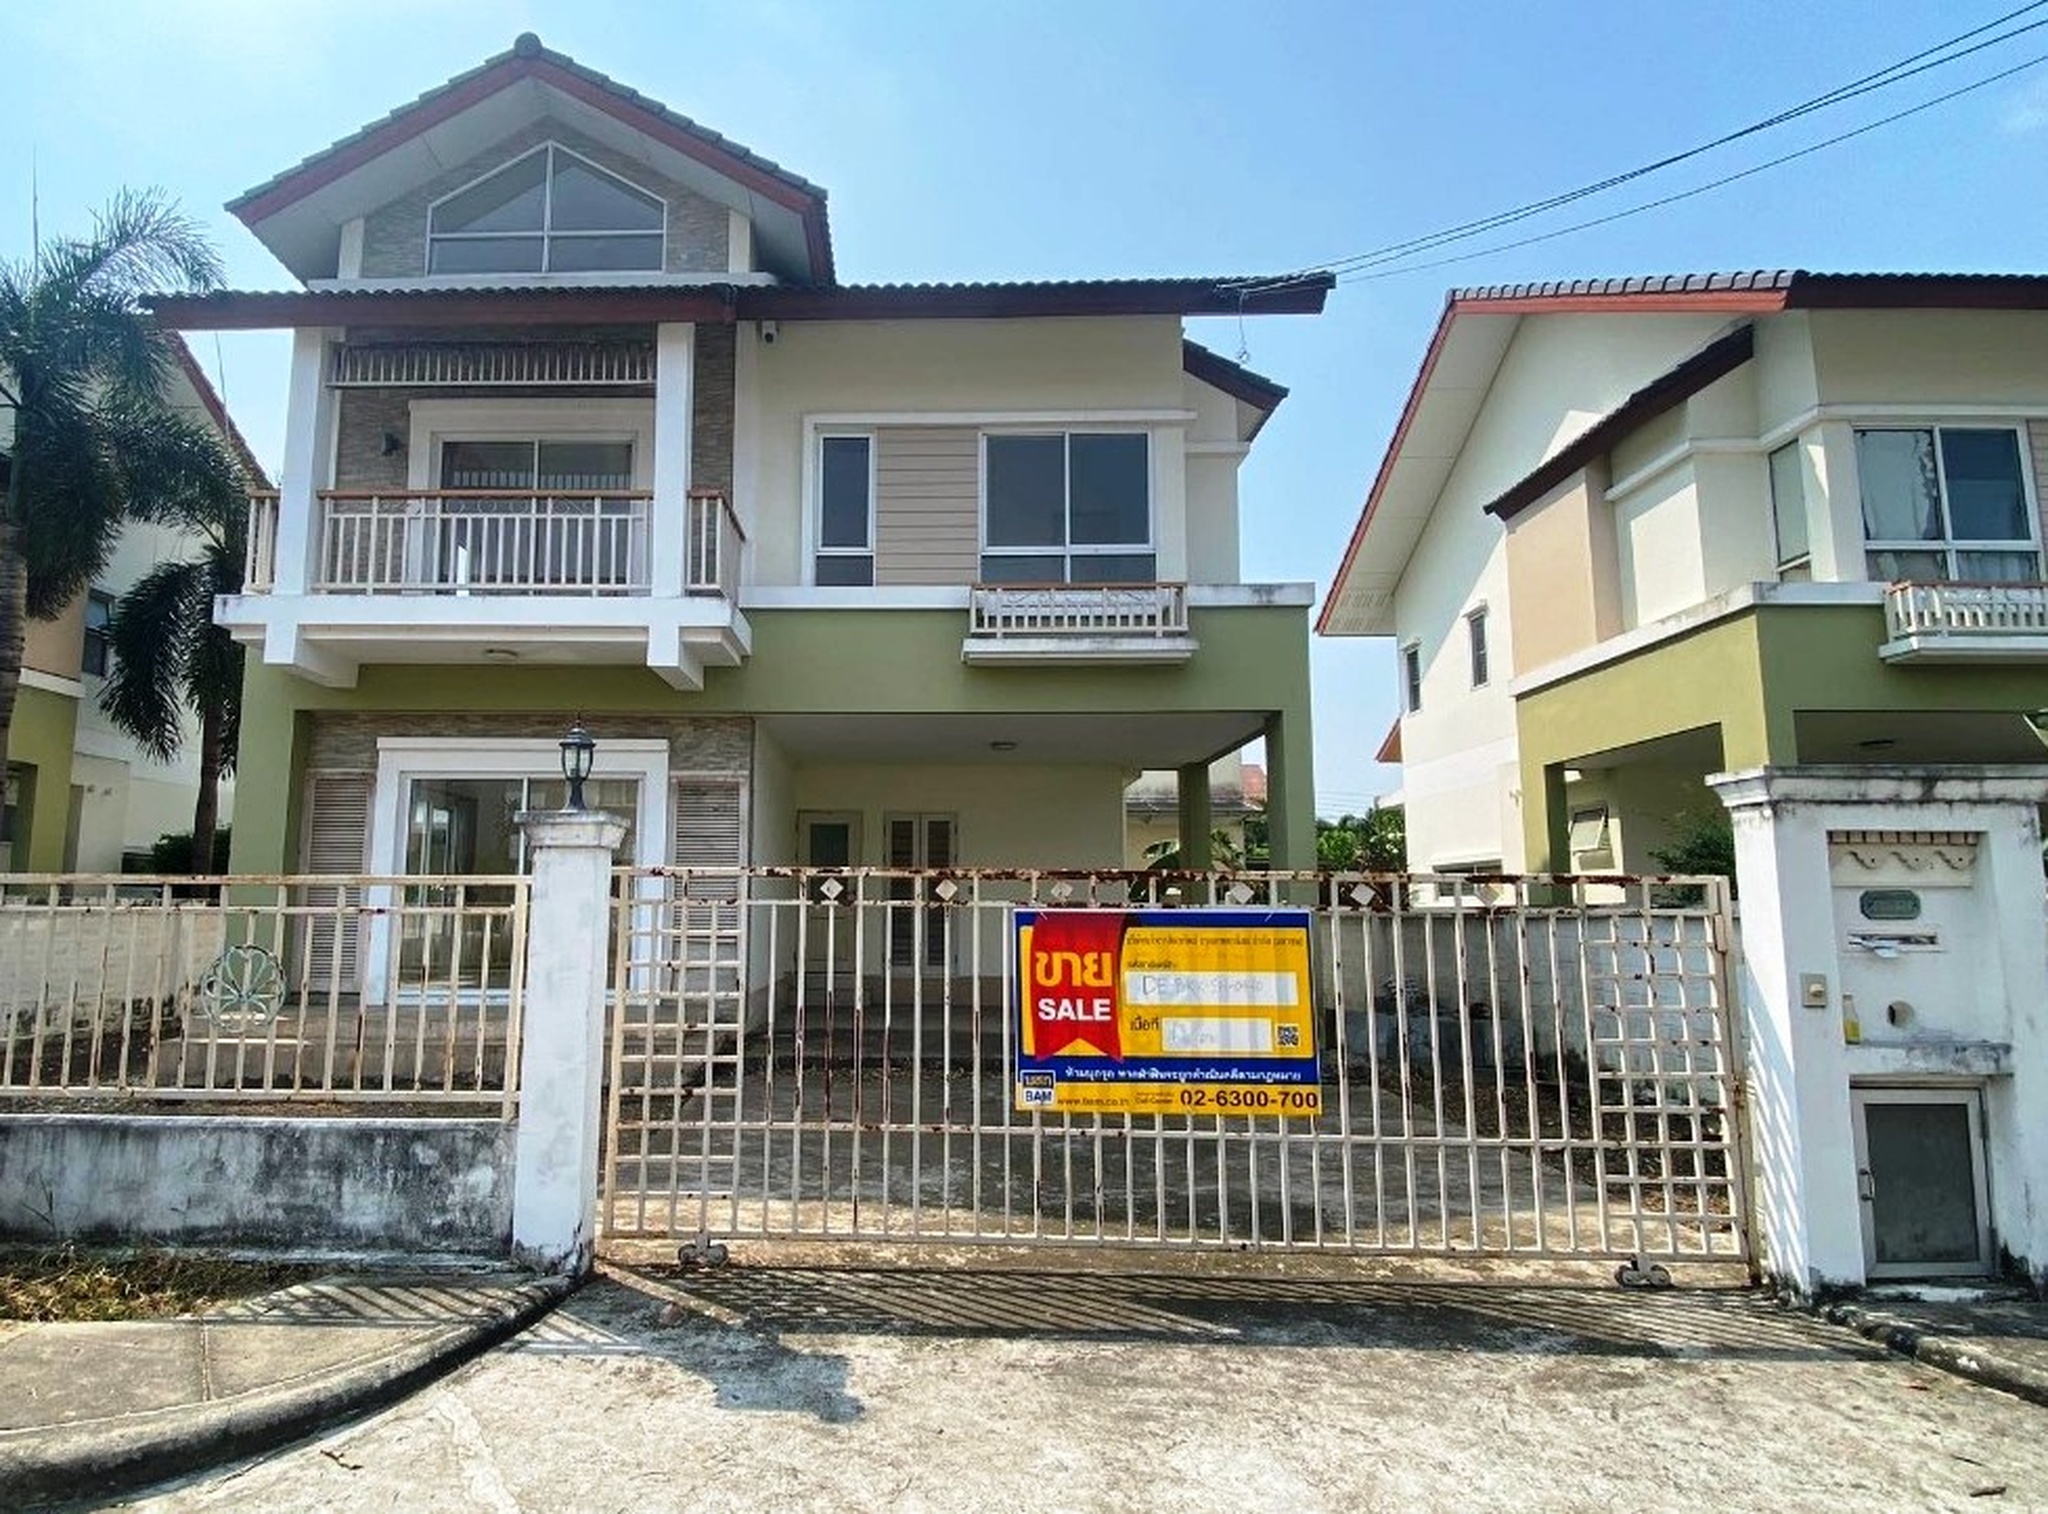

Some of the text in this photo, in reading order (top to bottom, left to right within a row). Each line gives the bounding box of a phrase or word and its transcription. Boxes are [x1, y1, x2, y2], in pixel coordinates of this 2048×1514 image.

[1035, 950, 1113, 988] ขาย
[1038, 997, 1112, 1021] SALE
[1025, 1090, 1052, 1102] BAM
[1180, 1089, 1318, 1109] 02-6300-700
